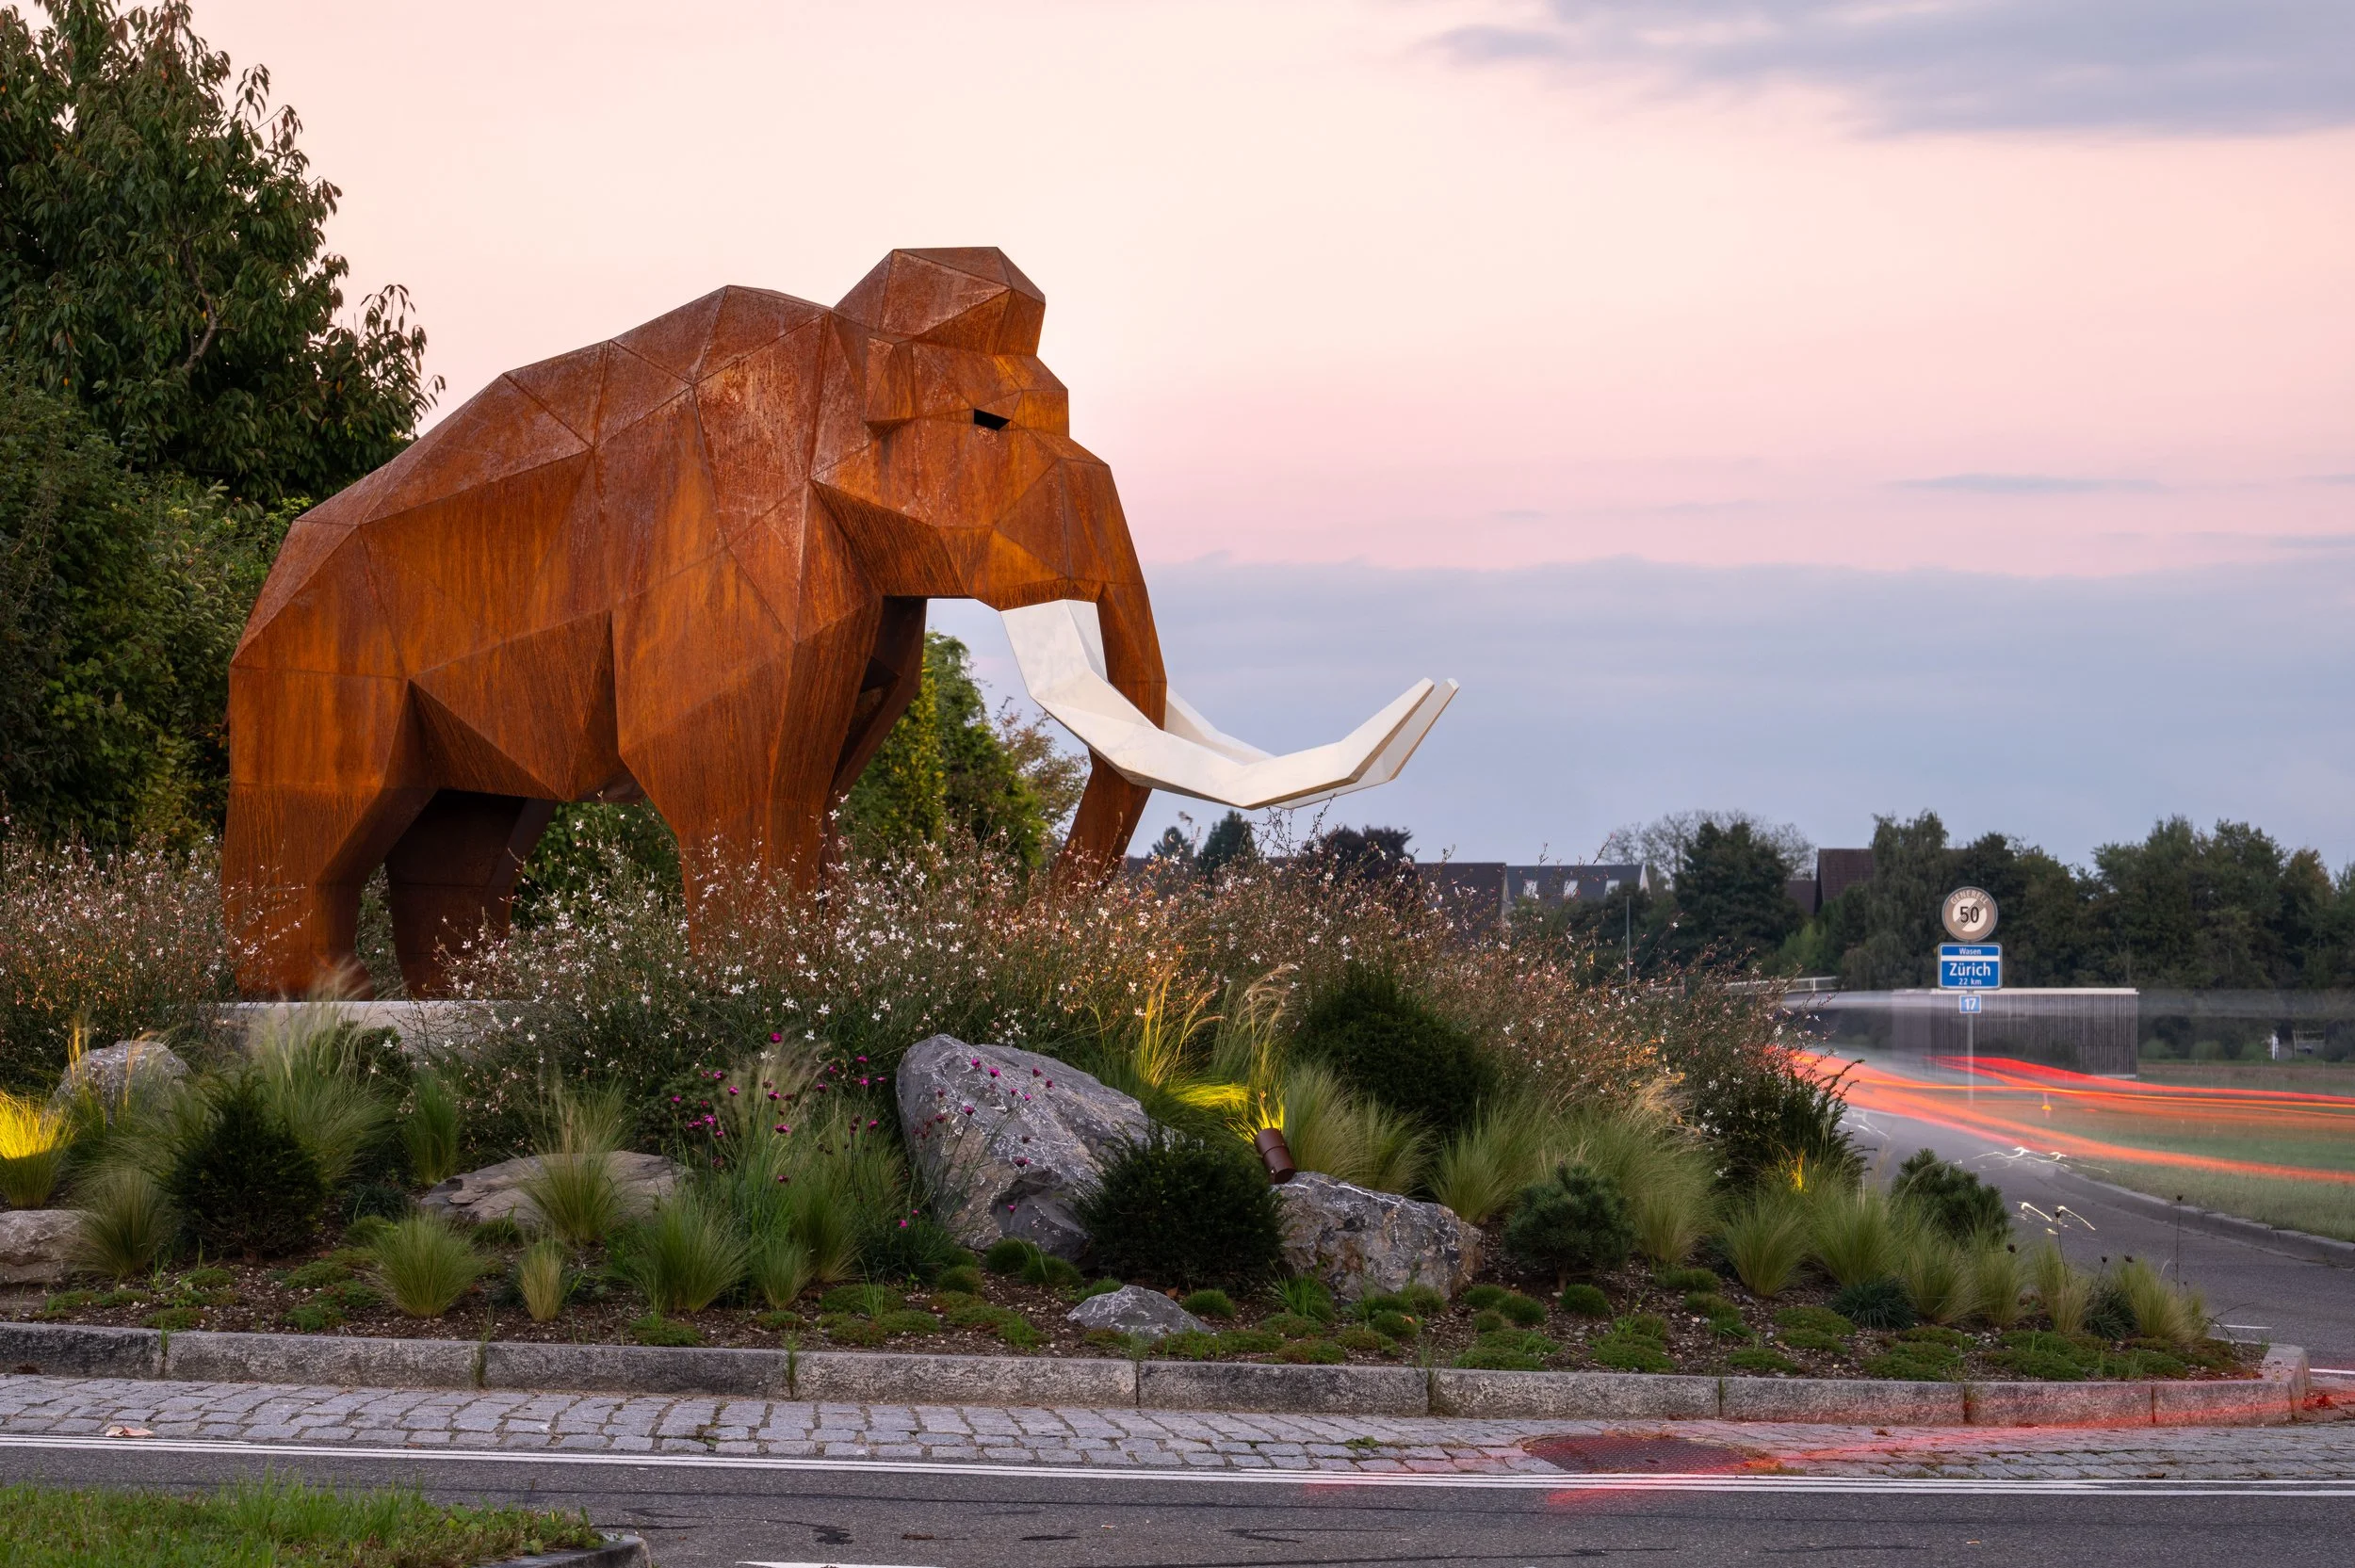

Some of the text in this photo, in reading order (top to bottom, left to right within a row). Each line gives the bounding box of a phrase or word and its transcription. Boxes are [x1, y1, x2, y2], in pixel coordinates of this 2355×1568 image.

[1951, 890, 1989, 905] GENERELL
[1959, 906, 1979, 923] 50
[1949, 962, 1990, 977] Zürich
[1964, 998, 1977, 1011] 17
